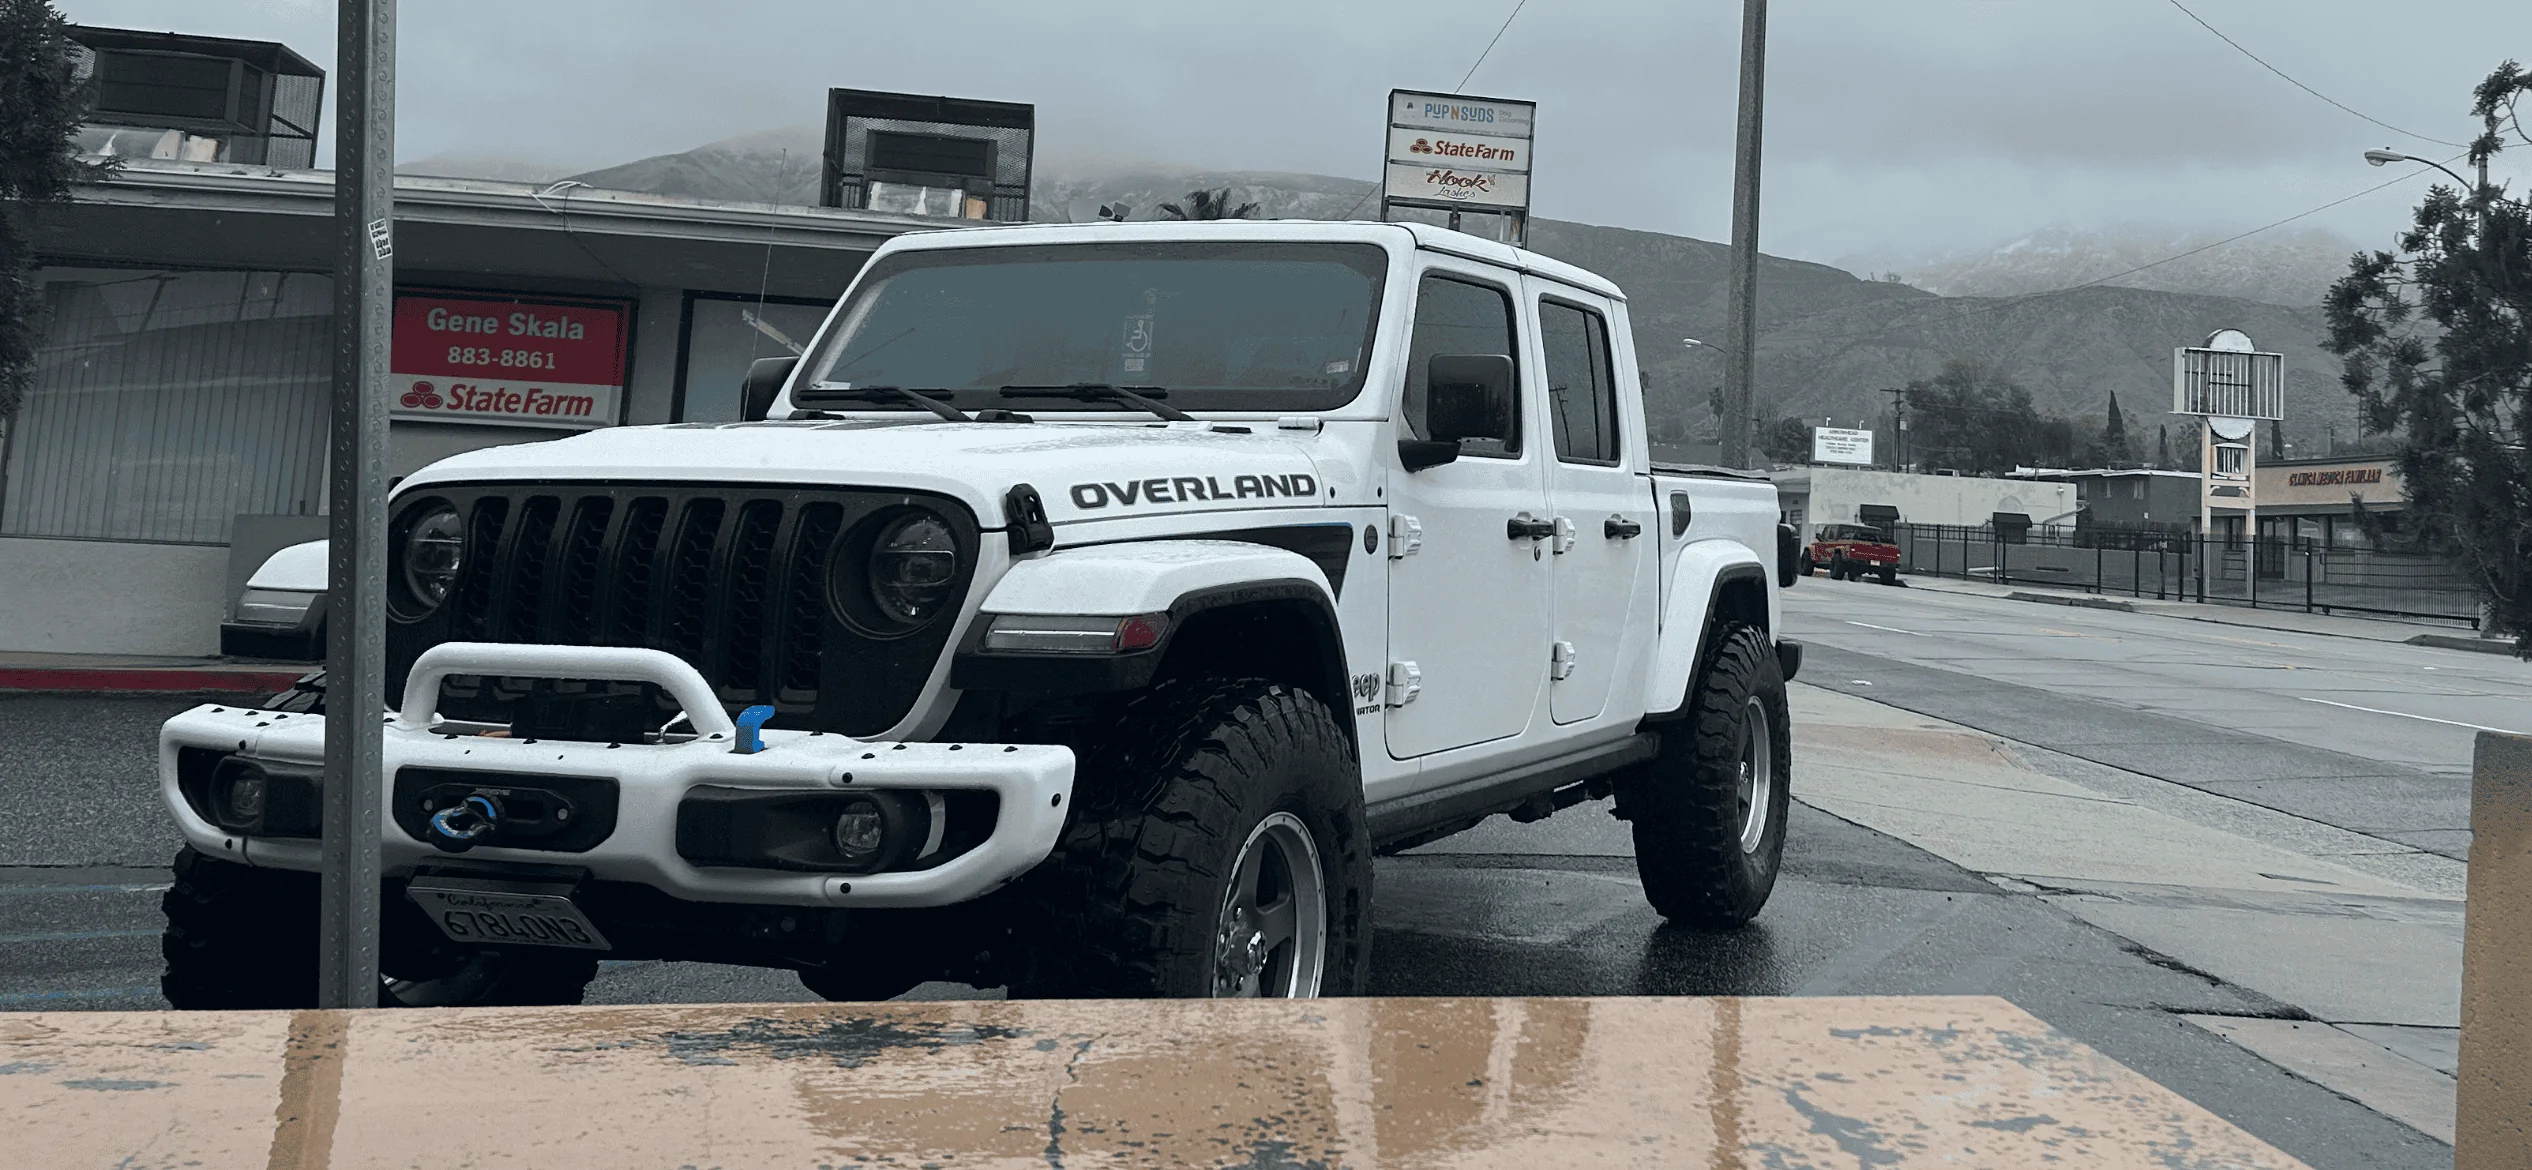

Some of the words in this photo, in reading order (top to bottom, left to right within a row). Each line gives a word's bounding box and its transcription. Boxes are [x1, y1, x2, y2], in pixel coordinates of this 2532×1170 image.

[427, 307, 499, 334] Gene
[508, 313, 585, 340] Skala
[447, 346, 556, 370] 883-8861
[1070, 473, 1317, 509] OVERLAND
[1351, 672, 1381, 703] eep
[1356, 703, 1381, 716] IATOR
